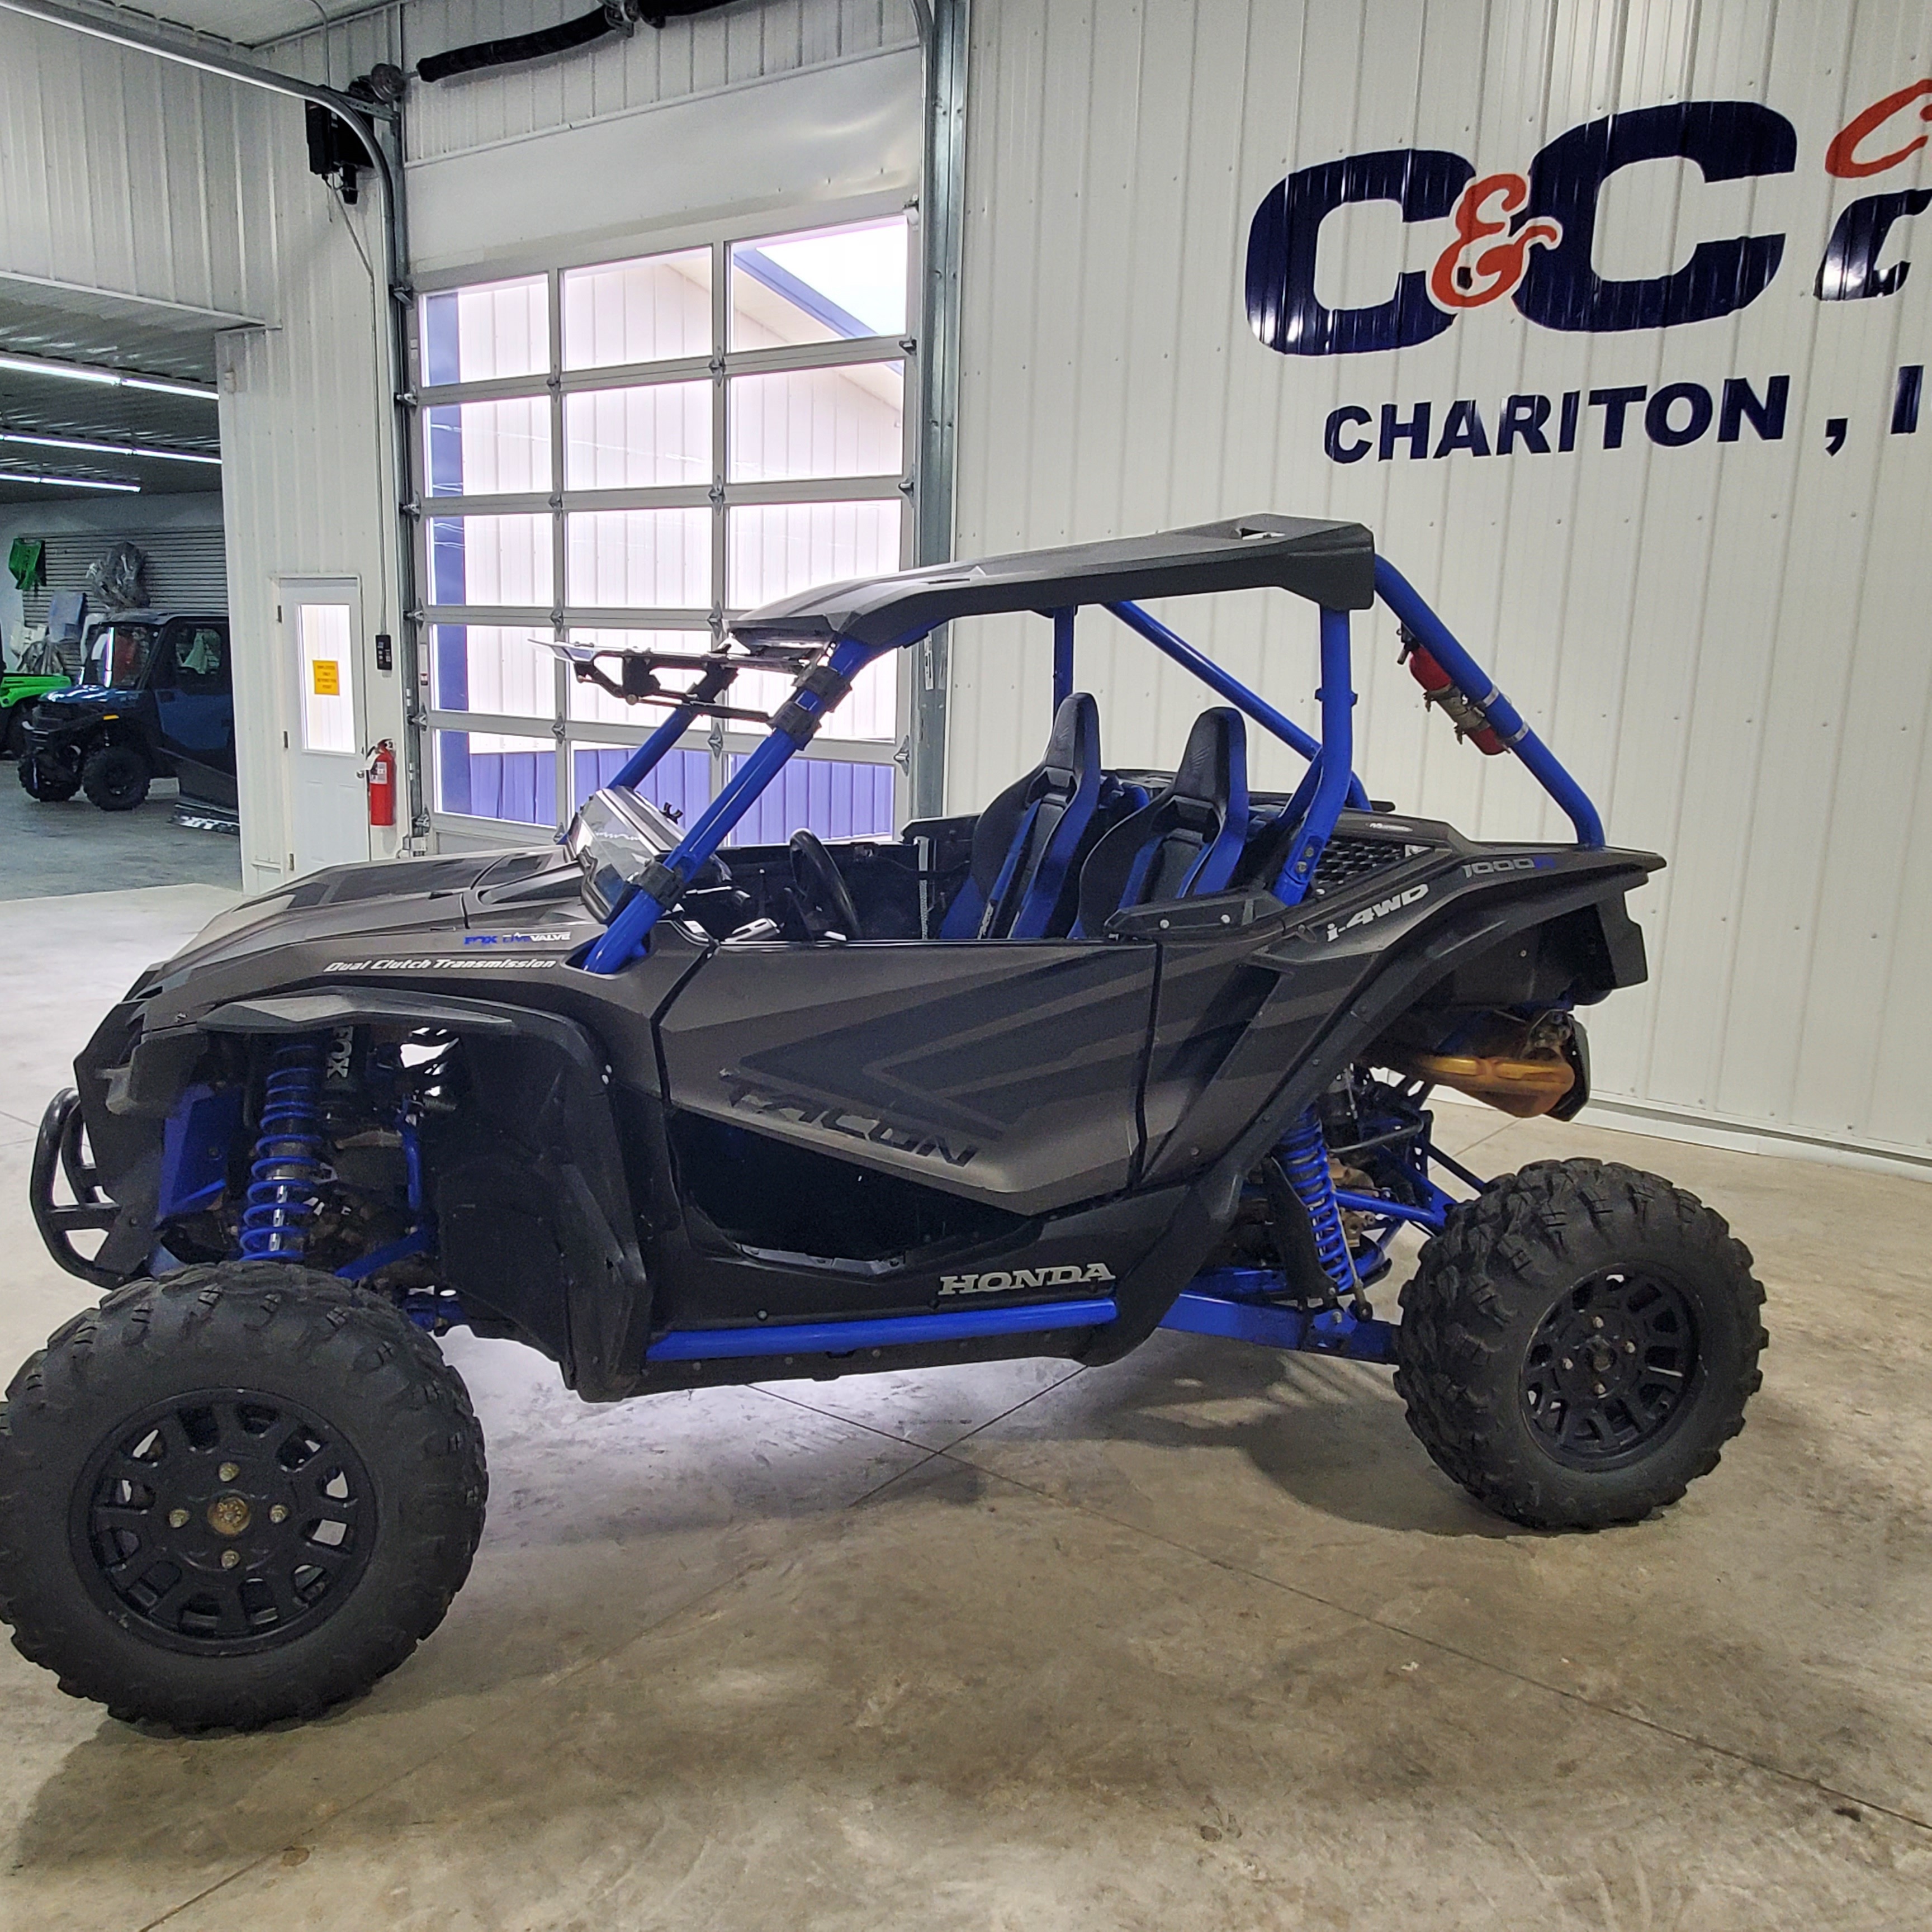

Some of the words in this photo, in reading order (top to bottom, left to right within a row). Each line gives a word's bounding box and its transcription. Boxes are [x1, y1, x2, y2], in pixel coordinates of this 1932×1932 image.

[1245, 101, 1797, 356] C&C
[1324, 375, 1791, 464] CHARITON
[1327, 883, 1429, 942] i-4WD
[323, 959, 373, 973] Dual
[370, 959, 432, 970] Clutch
[432, 958, 557, 968] Transmission
[937, 1262, 1116, 1296] HONDA
